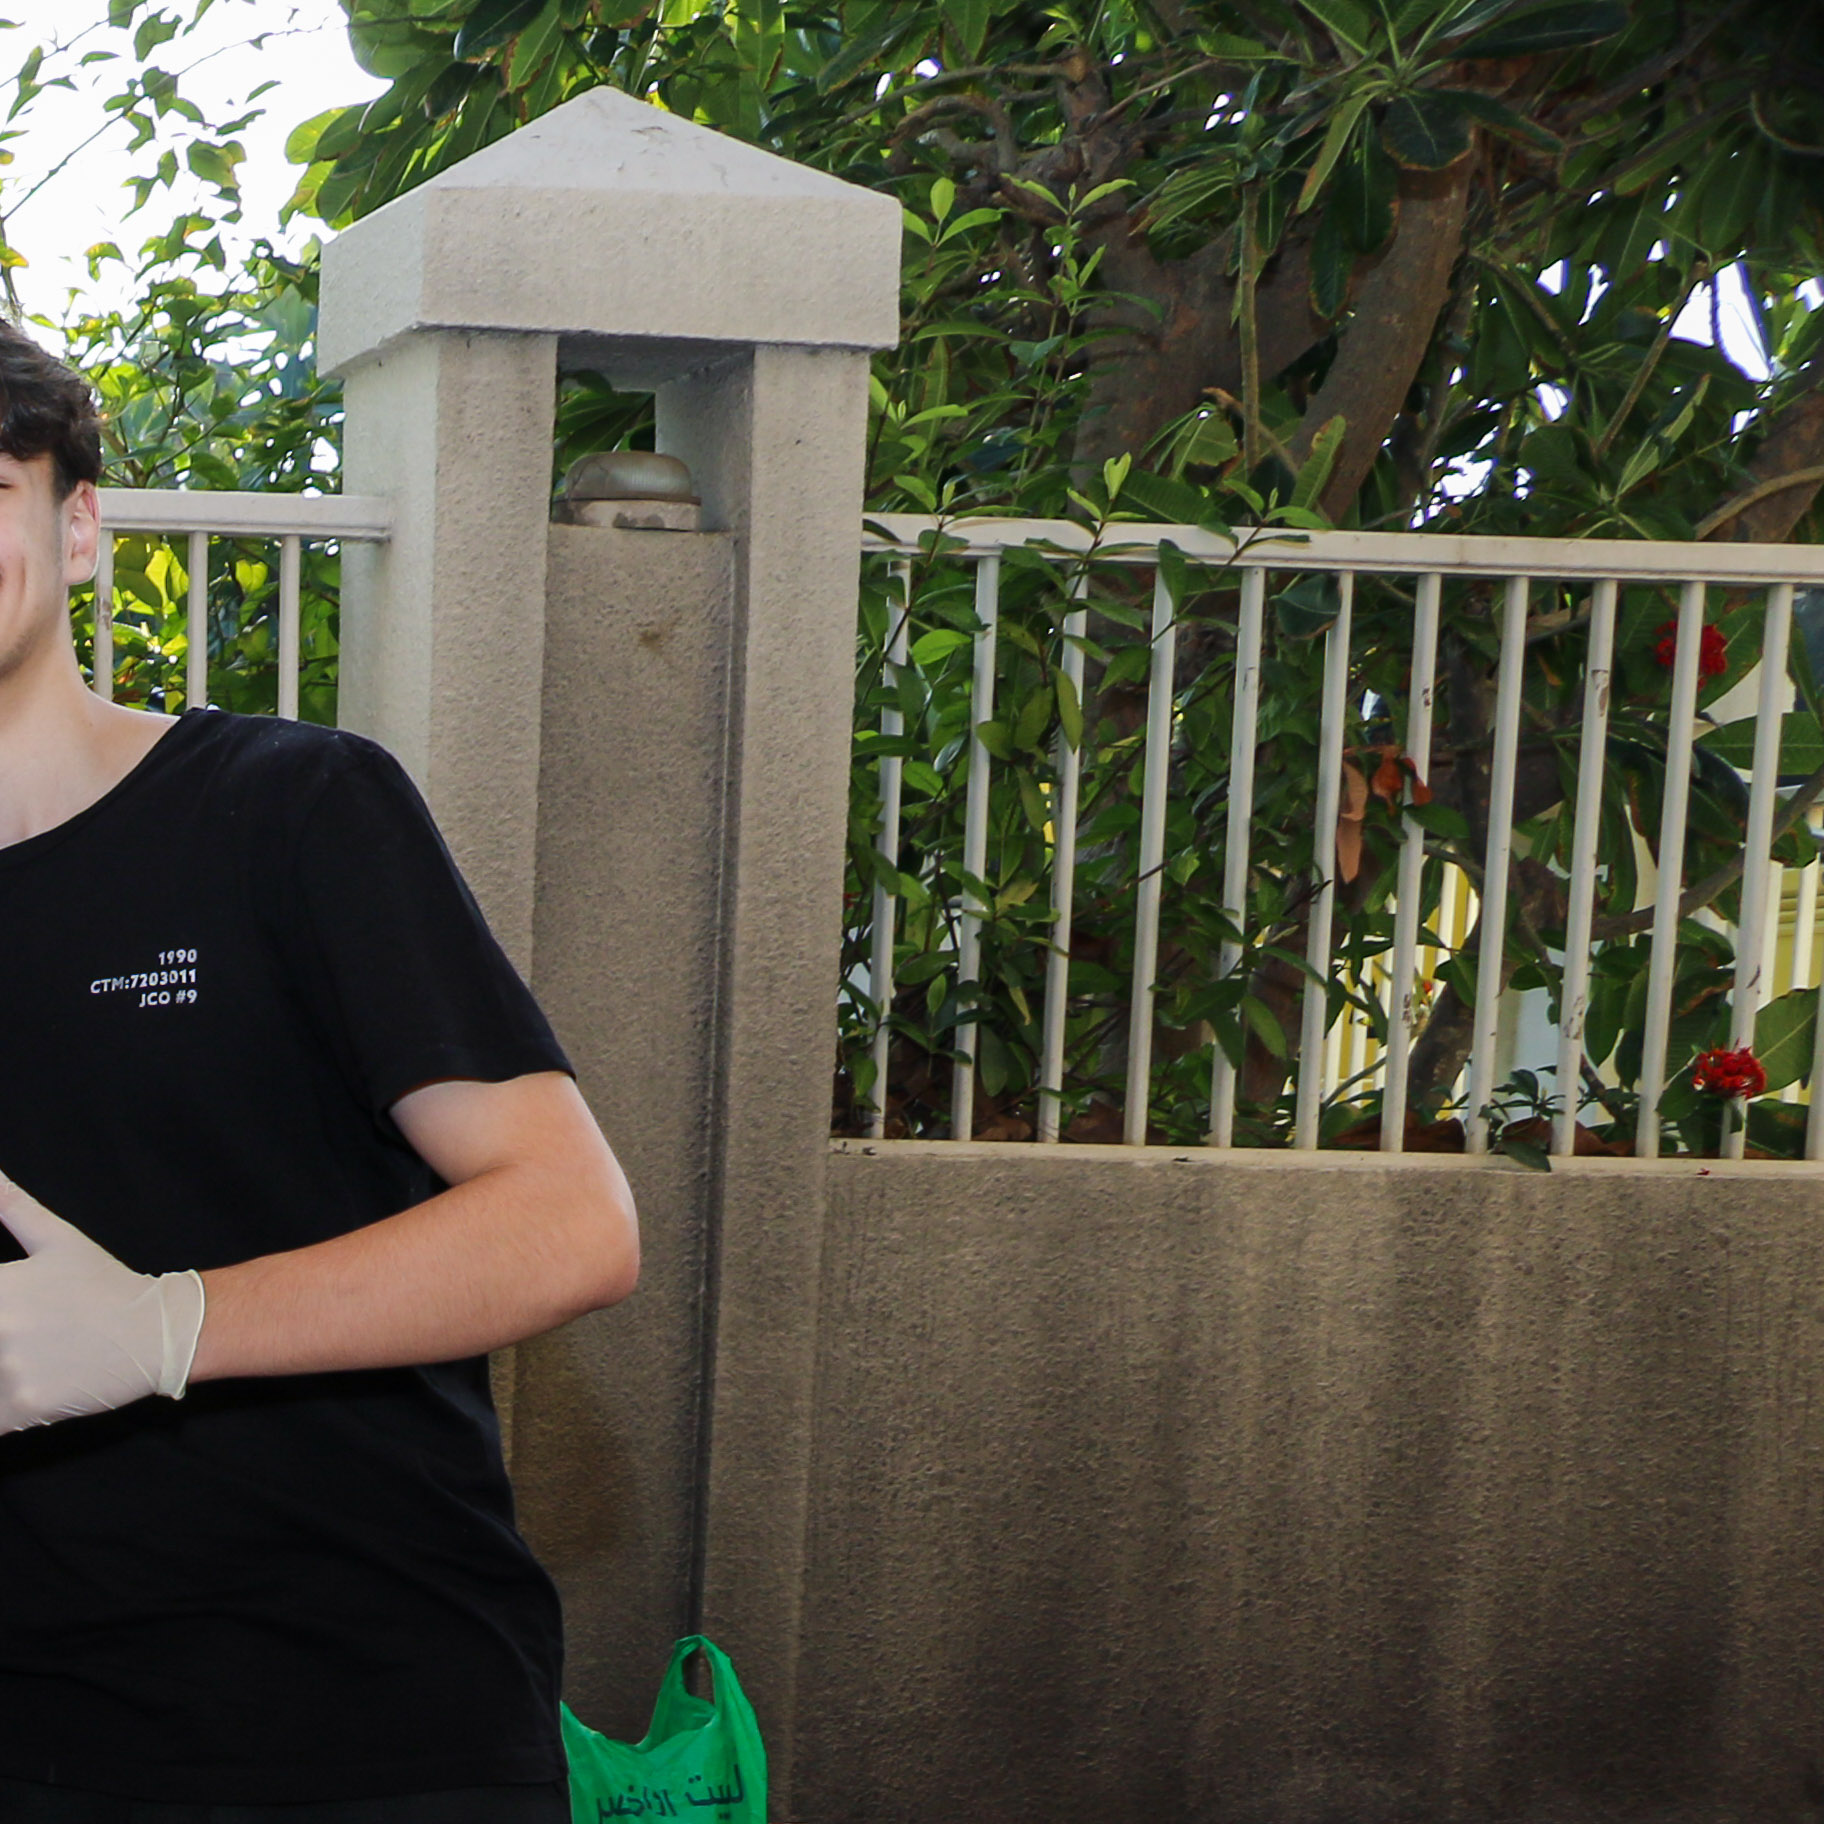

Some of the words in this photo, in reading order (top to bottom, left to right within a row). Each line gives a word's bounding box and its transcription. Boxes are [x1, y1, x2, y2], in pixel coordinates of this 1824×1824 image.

[158, 948, 198, 966] 1990
[90, 969, 197, 994] CTM:7203011
[138, 991, 171, 1008] JCO
[175, 989, 198, 1004] #9
